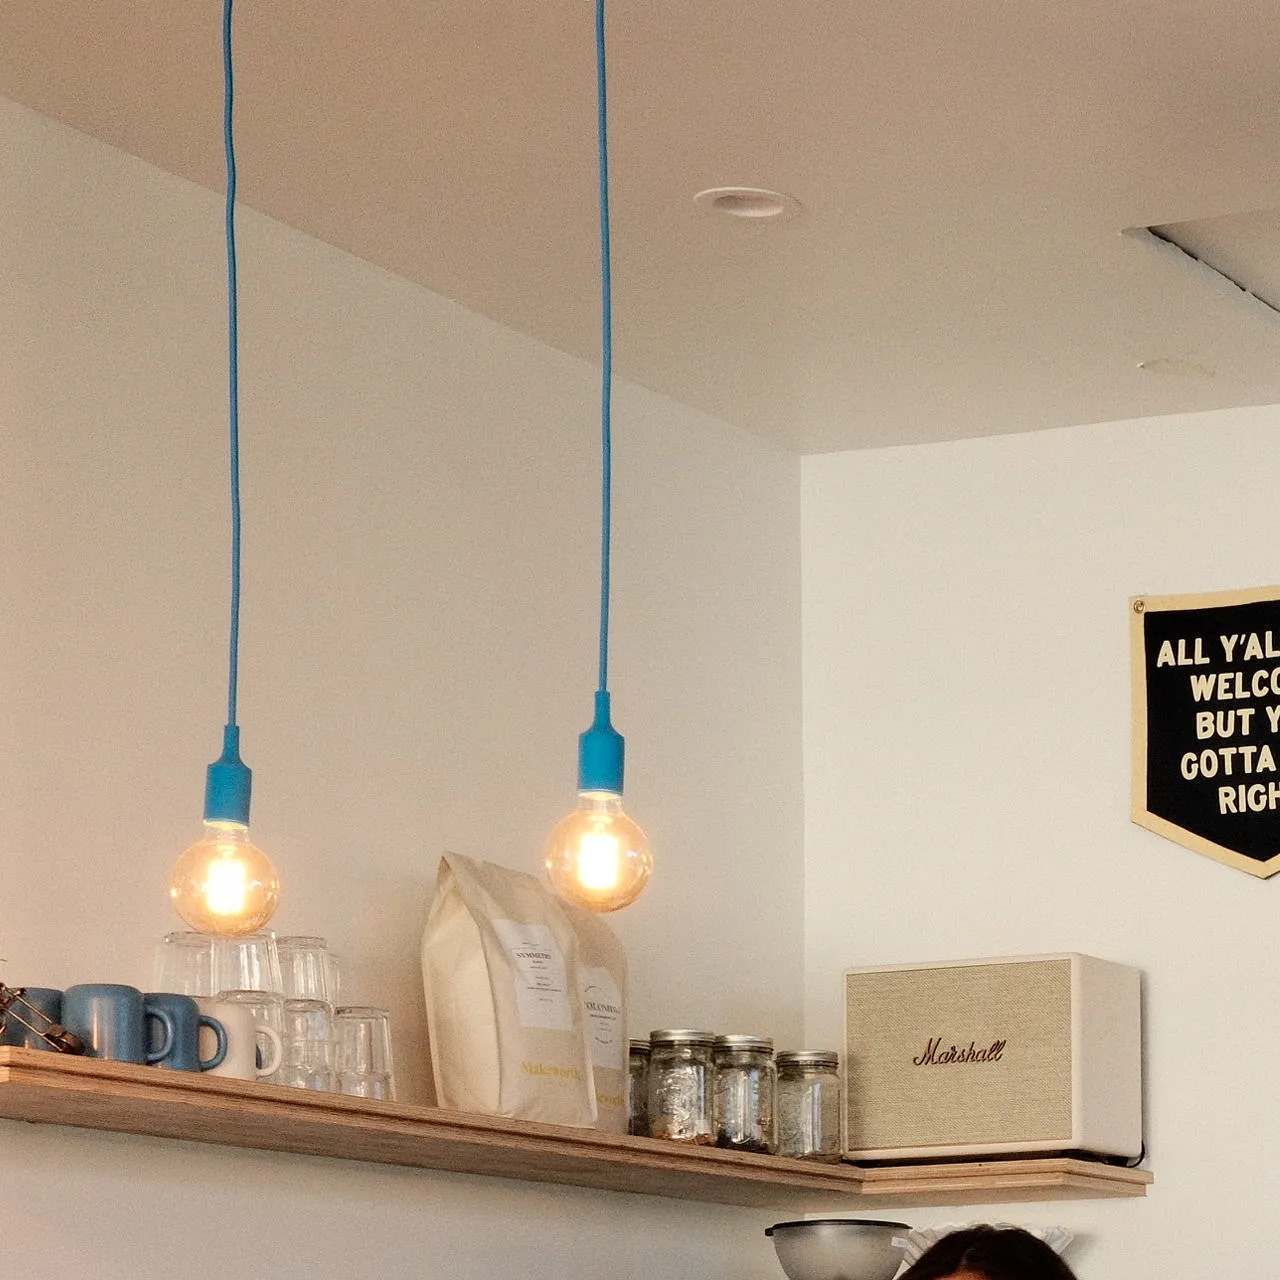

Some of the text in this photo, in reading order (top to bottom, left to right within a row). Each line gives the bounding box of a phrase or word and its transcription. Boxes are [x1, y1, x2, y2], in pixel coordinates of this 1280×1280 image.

[1156, 637, 1211, 668] ALL
[1196, 707, 1256, 740] BUT
[1180, 744, 1277, 781] GOTTA
[912, 1037, 1007, 1066] Marshall
